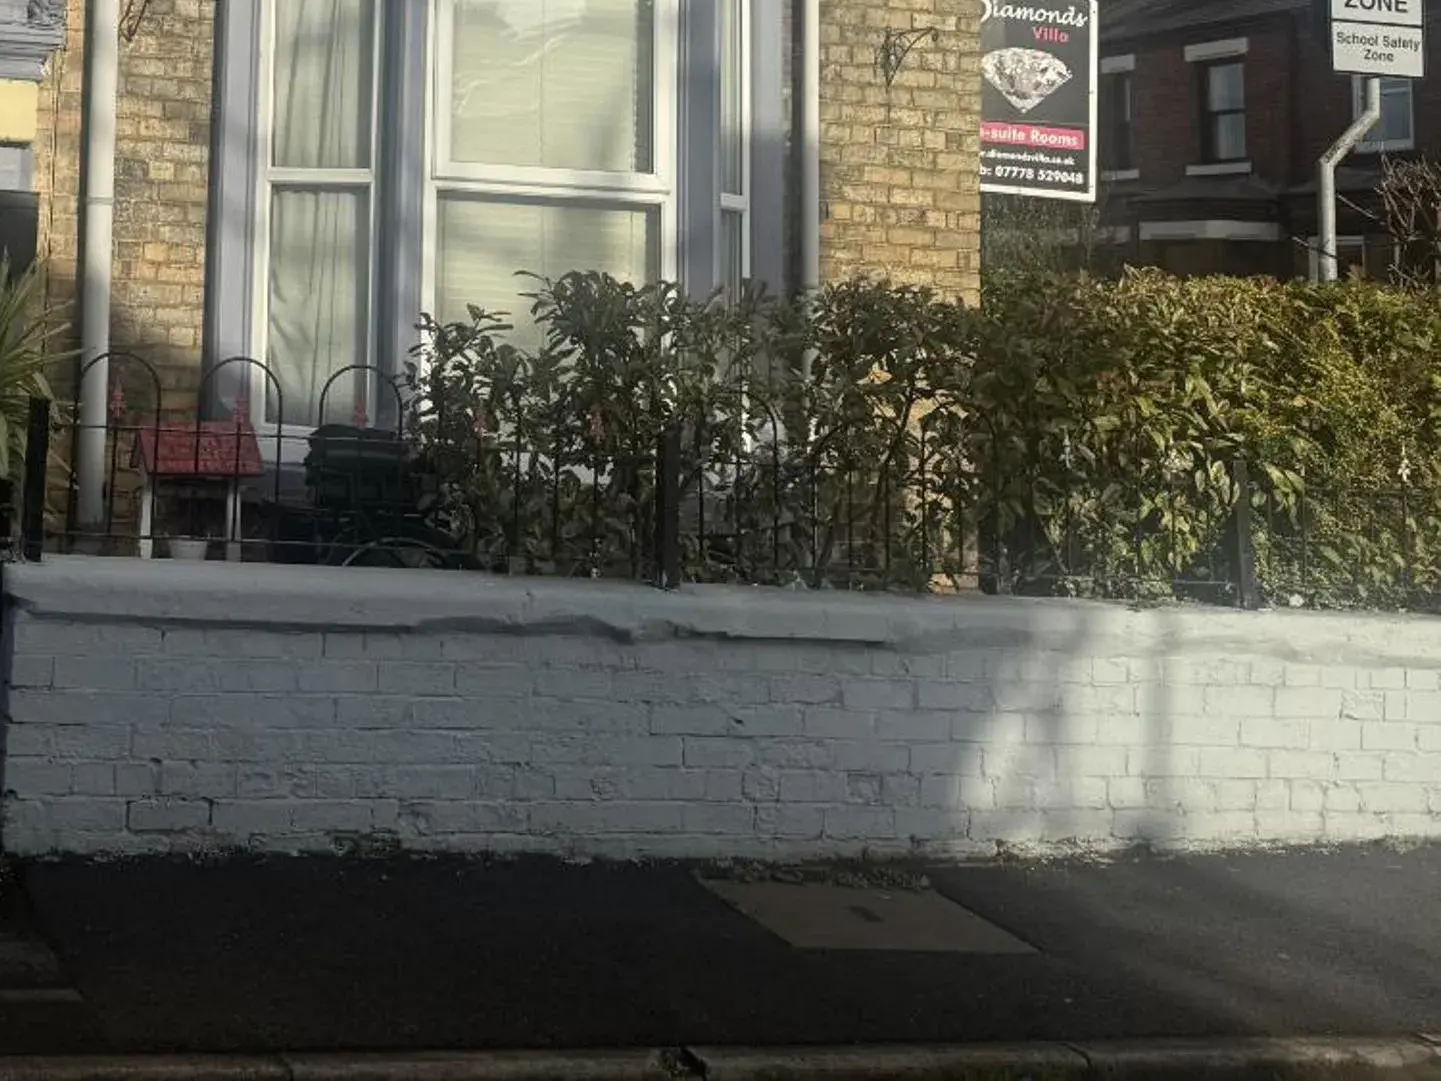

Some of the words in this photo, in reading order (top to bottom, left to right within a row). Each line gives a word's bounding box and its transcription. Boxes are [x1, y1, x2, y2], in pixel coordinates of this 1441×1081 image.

[1032, 26, 1069, 43] Villa
[1336, 31, 1378, 47] School
[1383, 35, 1420, 52] Safety
[1364, 49, 1394, 62] Zone
[1030, 128, 1078, 146] Rooms
